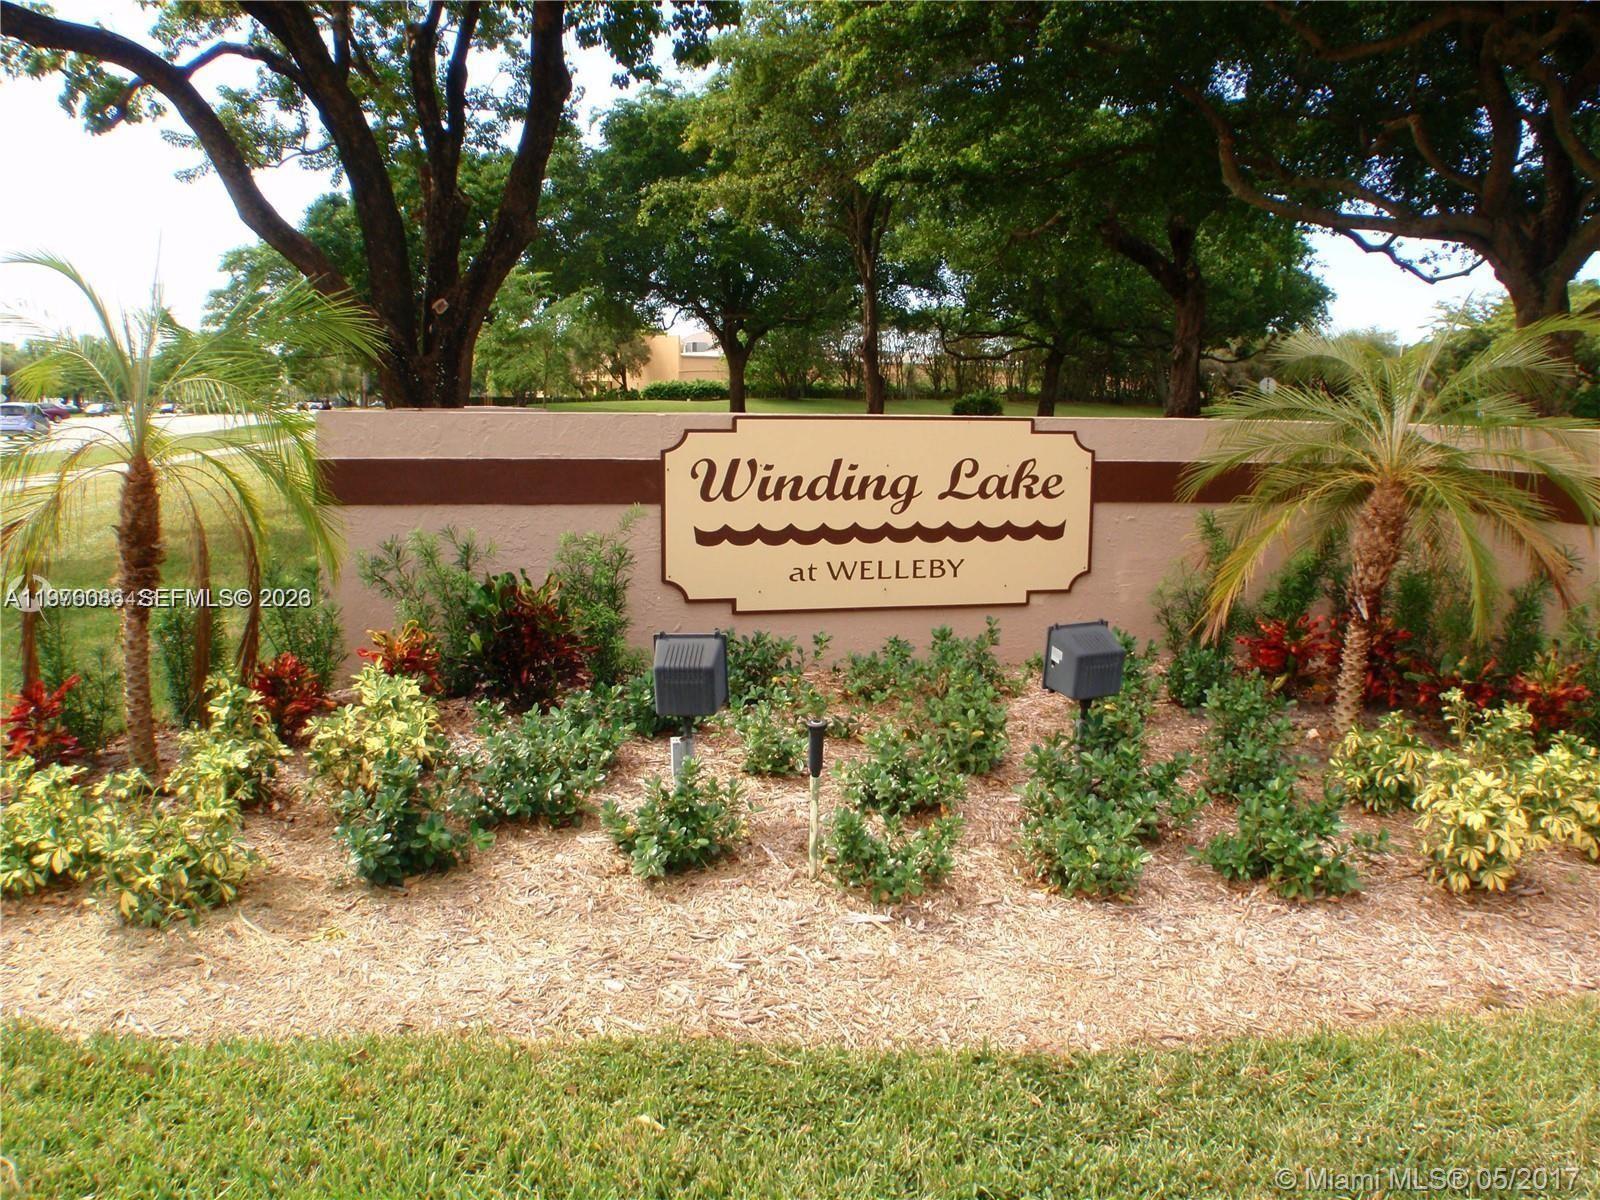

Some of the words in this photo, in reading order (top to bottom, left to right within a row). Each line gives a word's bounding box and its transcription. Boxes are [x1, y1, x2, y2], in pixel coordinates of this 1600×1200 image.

[690, 457, 923, 515] Winding
[937, 457, 1066, 500] Lake
[788, 563, 817, 582] at
[826, 558, 966, 581] WELLEBY
